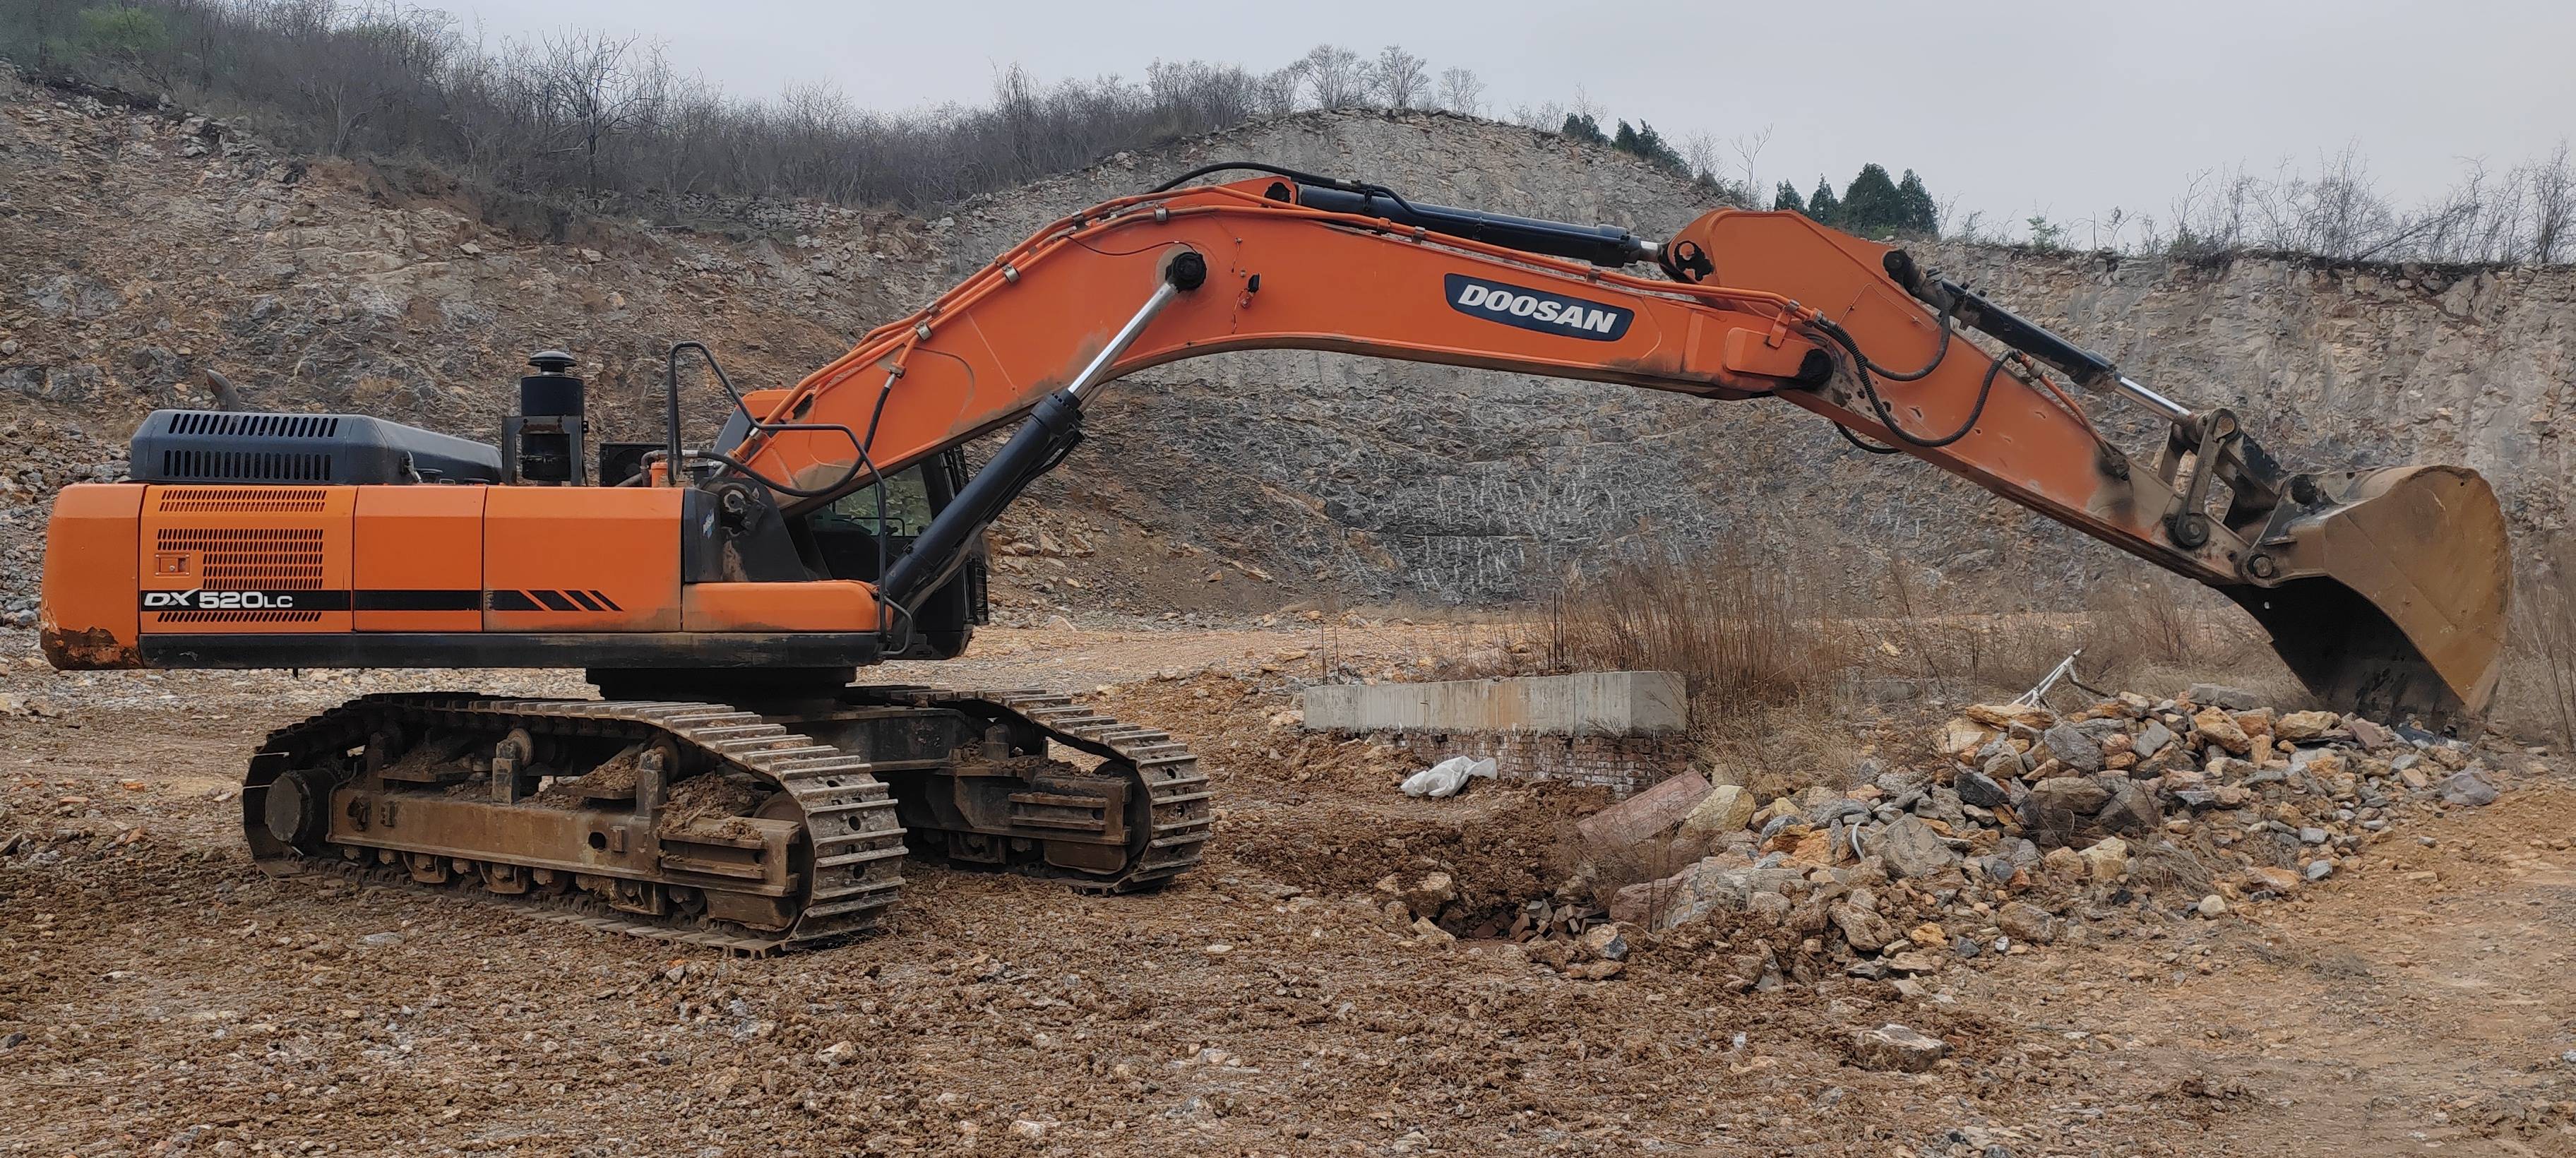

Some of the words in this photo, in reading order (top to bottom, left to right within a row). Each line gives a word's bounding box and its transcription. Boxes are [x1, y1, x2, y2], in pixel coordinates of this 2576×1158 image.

[1457, 284, 1617, 333] DOOSAN
[144, 587, 201, 607] DX
[198, 591, 293, 609] 520LC
